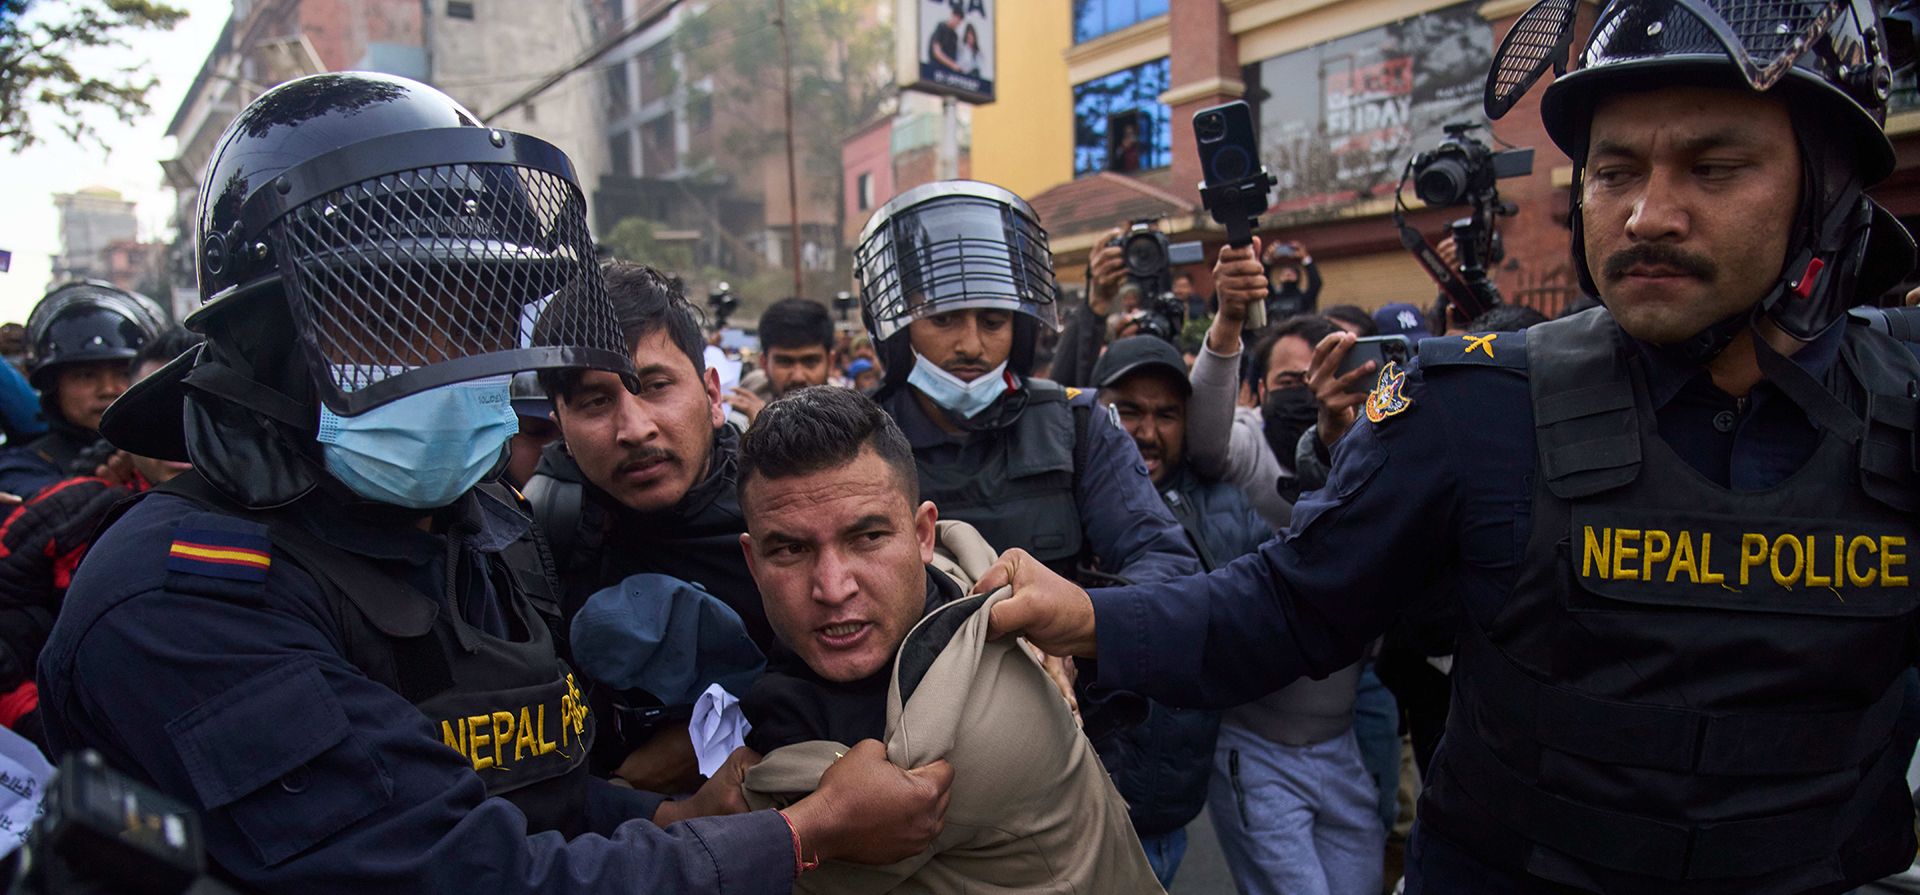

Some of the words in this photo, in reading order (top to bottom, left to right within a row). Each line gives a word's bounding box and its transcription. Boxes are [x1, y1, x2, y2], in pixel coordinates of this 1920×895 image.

[1582, 525, 1724, 584] NEPAL
[1739, 533, 1909, 588] POLICE
[441, 703, 557, 771] NEPAL
